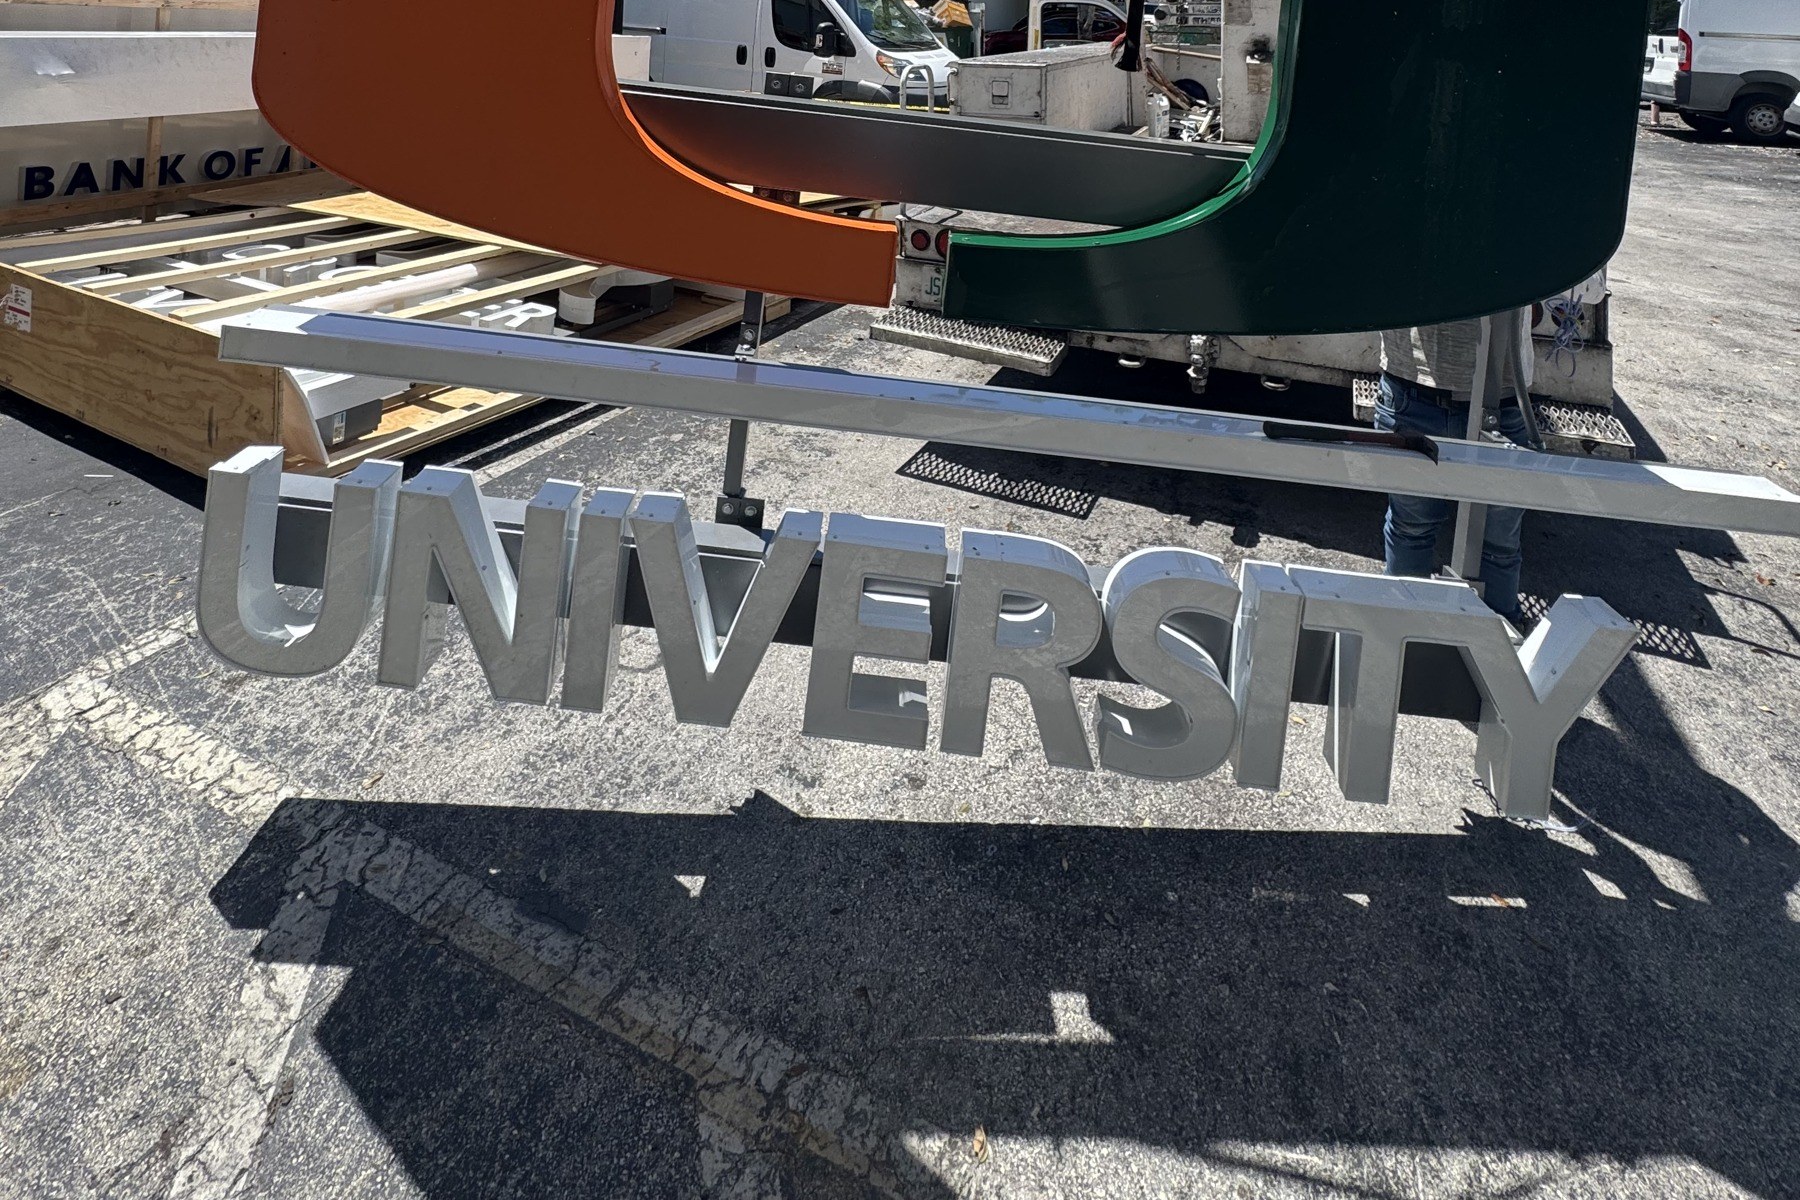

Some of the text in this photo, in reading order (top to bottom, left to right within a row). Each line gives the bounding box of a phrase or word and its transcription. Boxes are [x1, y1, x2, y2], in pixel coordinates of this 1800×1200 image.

[19, 153, 186, 201] BANK
[198, 146, 264, 181] OF
[196, 445, 1640, 821] UNIVERSITY
